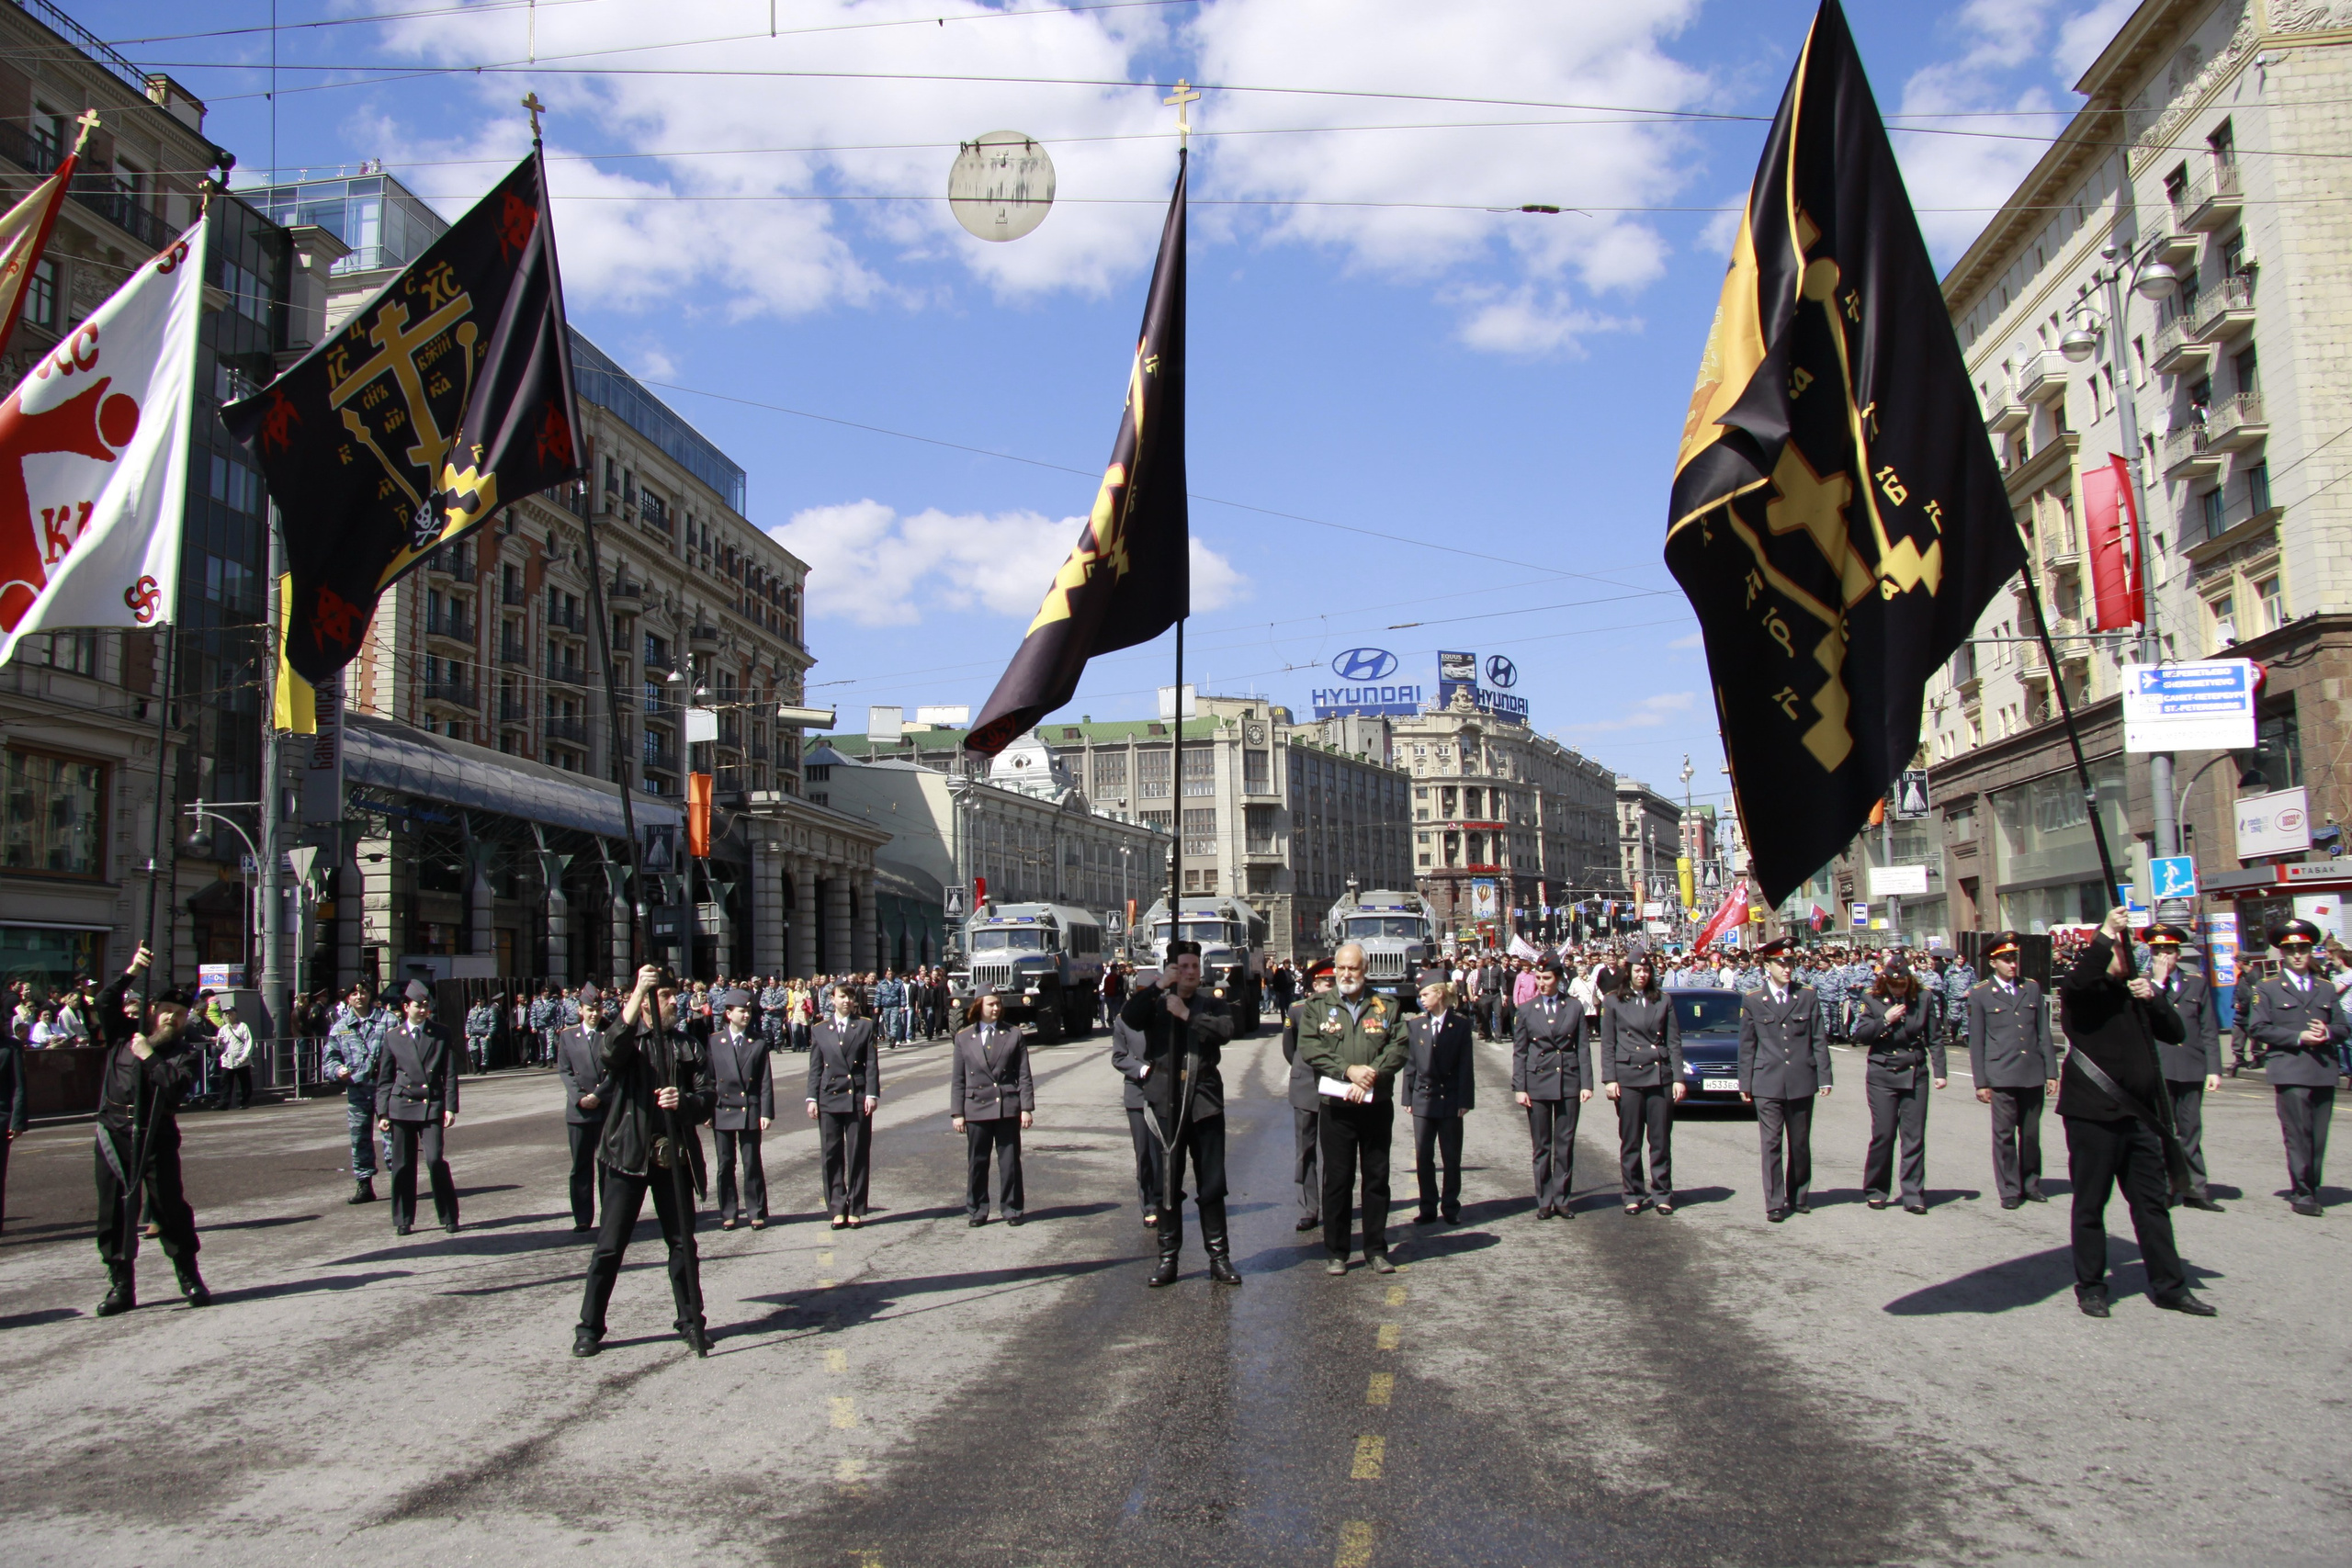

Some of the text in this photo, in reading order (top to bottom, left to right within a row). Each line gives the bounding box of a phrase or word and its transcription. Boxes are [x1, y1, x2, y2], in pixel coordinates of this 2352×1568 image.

[1312, 685, 1421, 705] HYUNDAI
[1476, 687, 1529, 714] HYUNDAI
[2301, 866, 2335, 874] ТАБАК
[1727, 931, 1736, 942] P
